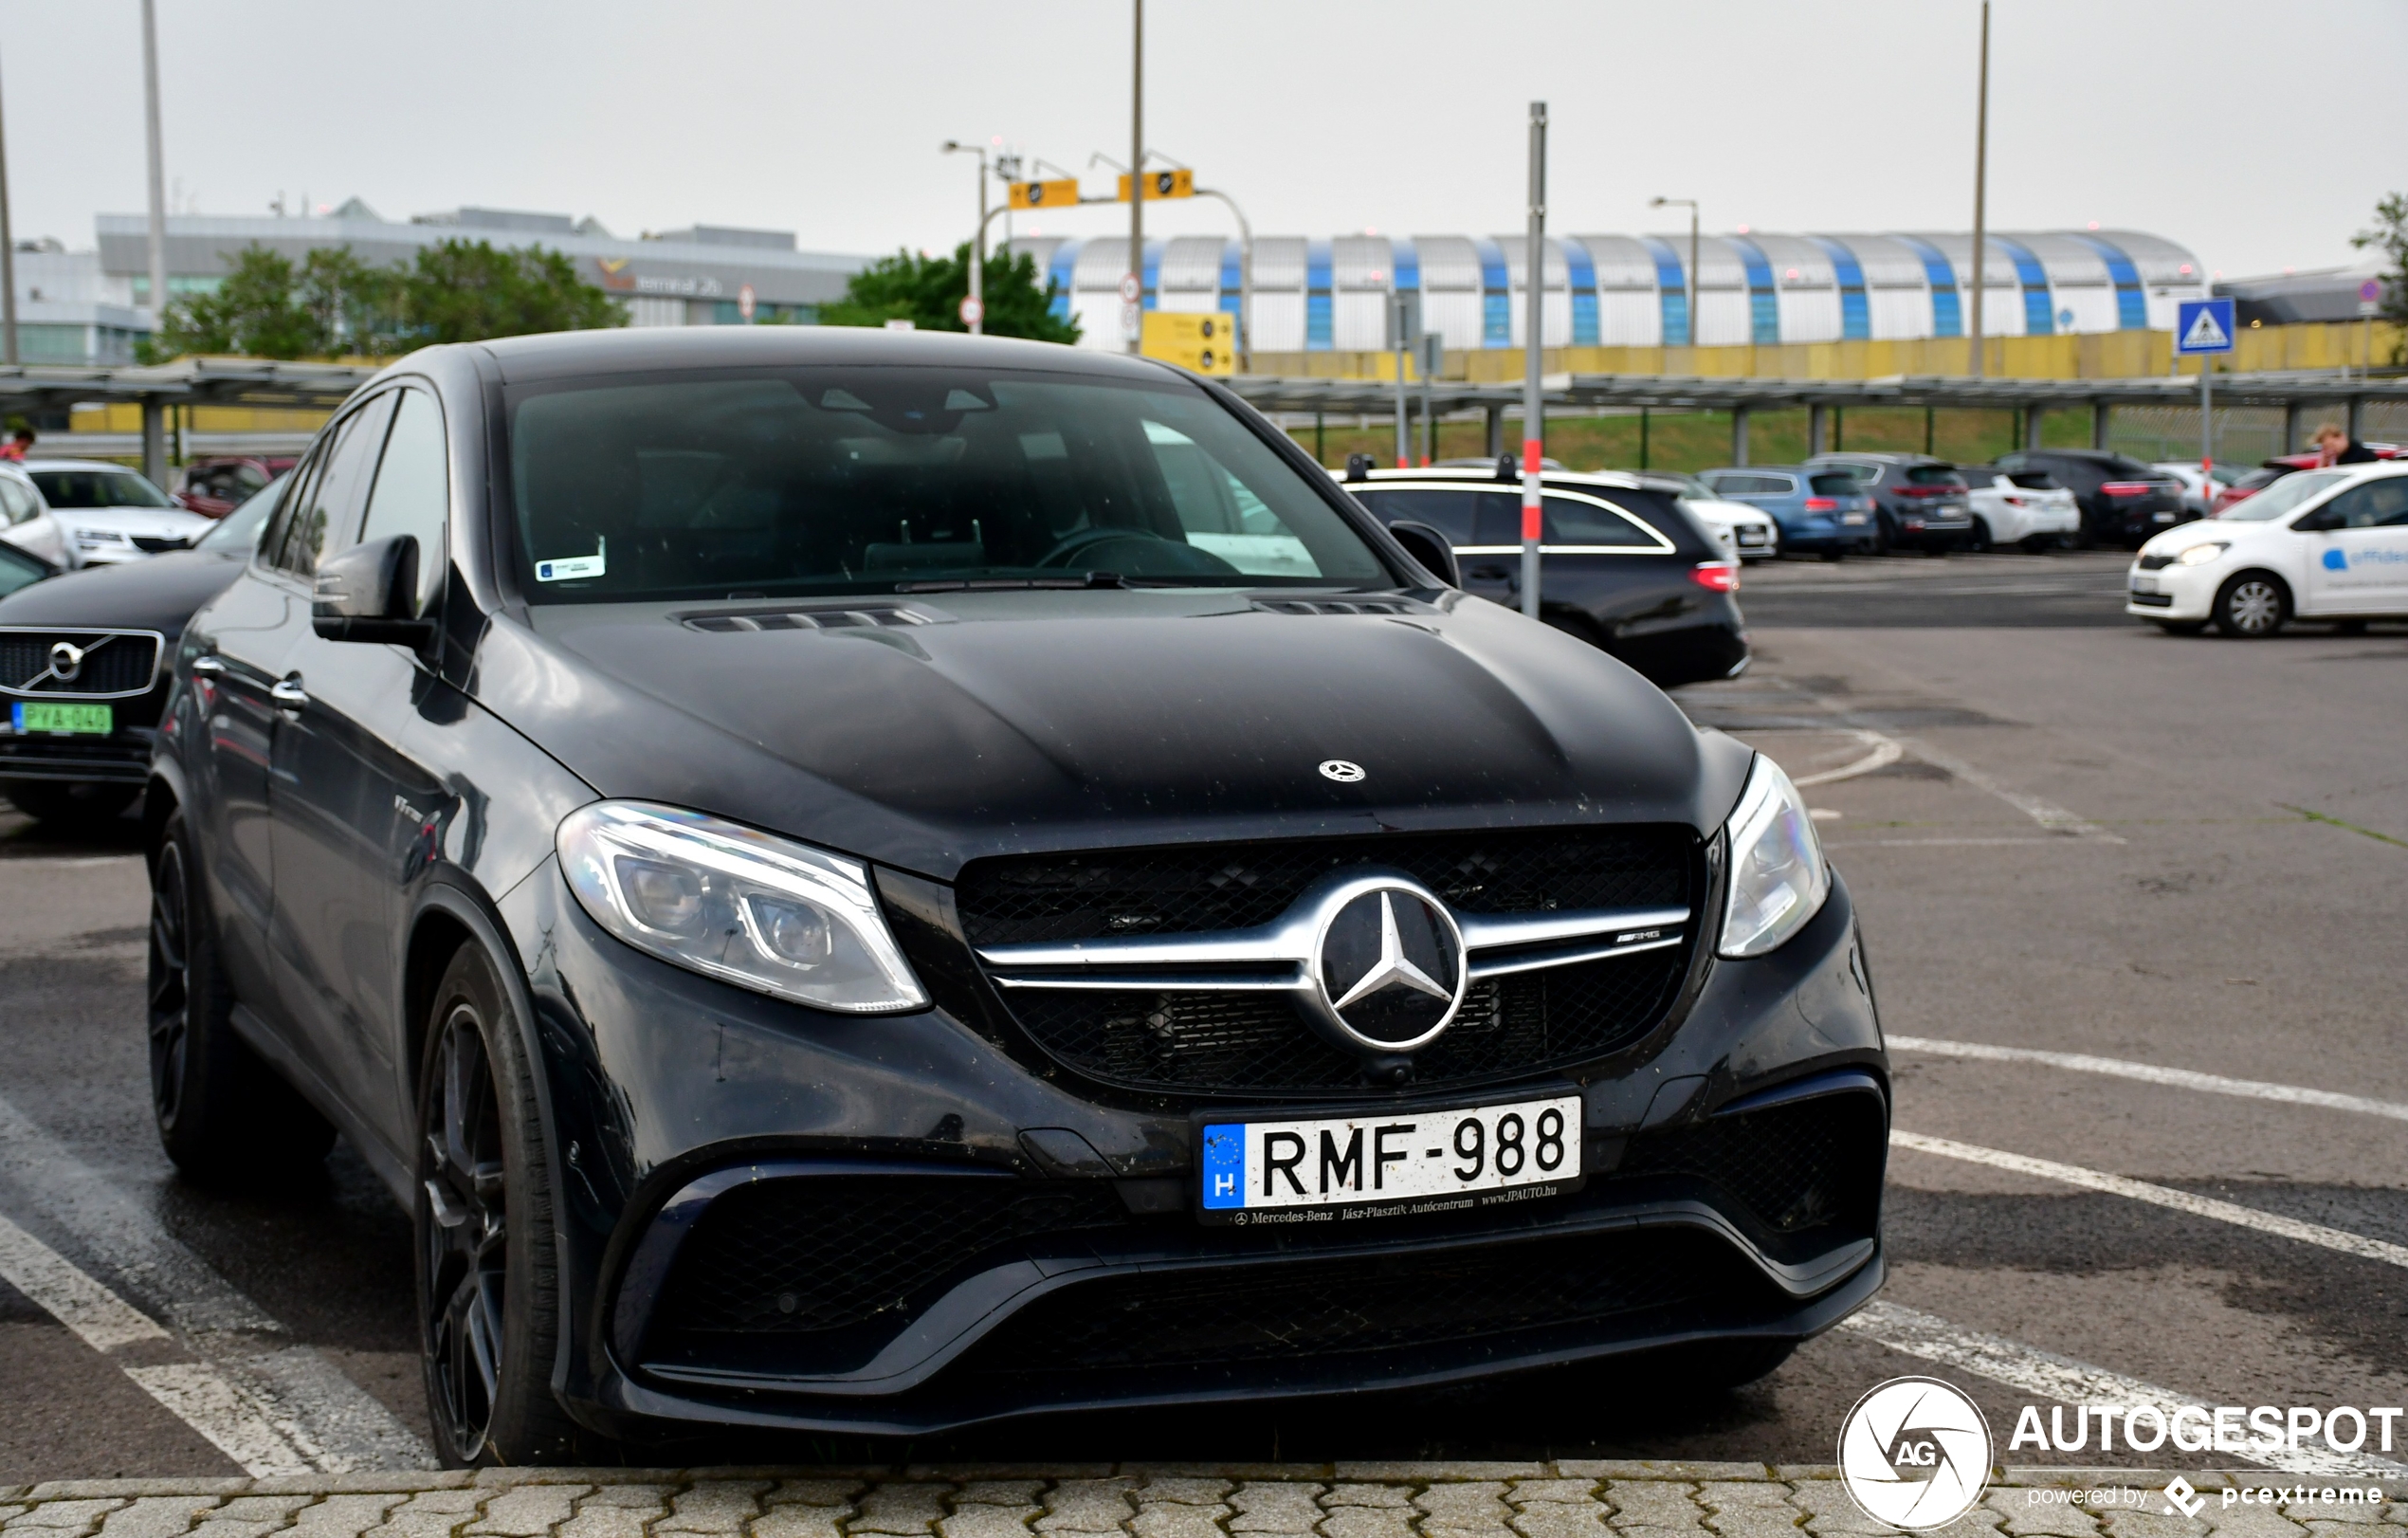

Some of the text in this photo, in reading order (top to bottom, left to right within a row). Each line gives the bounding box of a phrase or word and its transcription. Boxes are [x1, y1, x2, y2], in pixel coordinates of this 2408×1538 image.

[637, 276, 697, 295] terminal
[1263, 1108, 1565, 1197] RMF-988
[1214, 1172, 1234, 1198] H
[1250, 1210, 1333, 1224] Mercedes-Benz
[1341, 1204, 1408, 1221] Jász-Plasztik
[1409, 1199, 1474, 1215] Autócentrum
